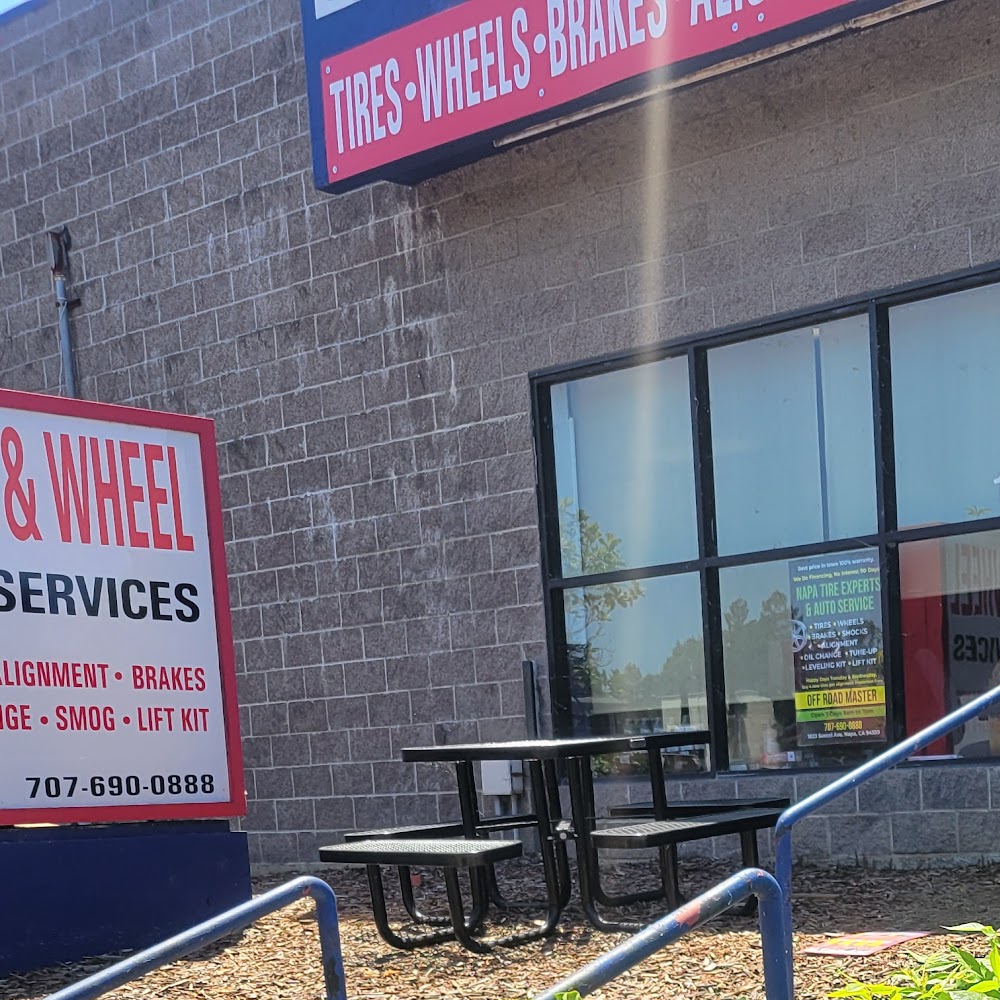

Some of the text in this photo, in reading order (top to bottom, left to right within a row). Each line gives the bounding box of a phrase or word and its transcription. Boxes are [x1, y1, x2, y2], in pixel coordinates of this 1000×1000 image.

[329, 57, 403, 154] TIRES
[414, 8, 533, 123] WHEELS
[1, 426, 195, 552] & WHEEL
[0, 570, 200, 623] SERVICES
[796, 577, 881, 601] NAPA TIRE EXPERTS
[805, 596, 875, 617] & AUTO SERVICE
[811, 628, 868, 640] BRAKES SHOCKS
[813, 618, 864, 630] TIRES WHEELS
[815, 651, 842, 660] CHANGE
[849, 647, 878, 657] TUNE-UP
[822, 639, 858, 649] ALIGNMENT
[805, 661, 835, 671] LEVELING
[835, 660, 847, 668] KIT
[852, 659, 865, 667] LIFT
[132, 665, 206, 692] BRAKES
[807, 689, 877, 707] OFF ROAD MASTER
[55, 705, 116, 732] SMOG
[137, 706, 174, 732] LIFT
[181, 708, 209, 733] KIT
[824, 721, 863, 731] 707-690-0888
[25, 773, 215, 799] 707-690-0888
